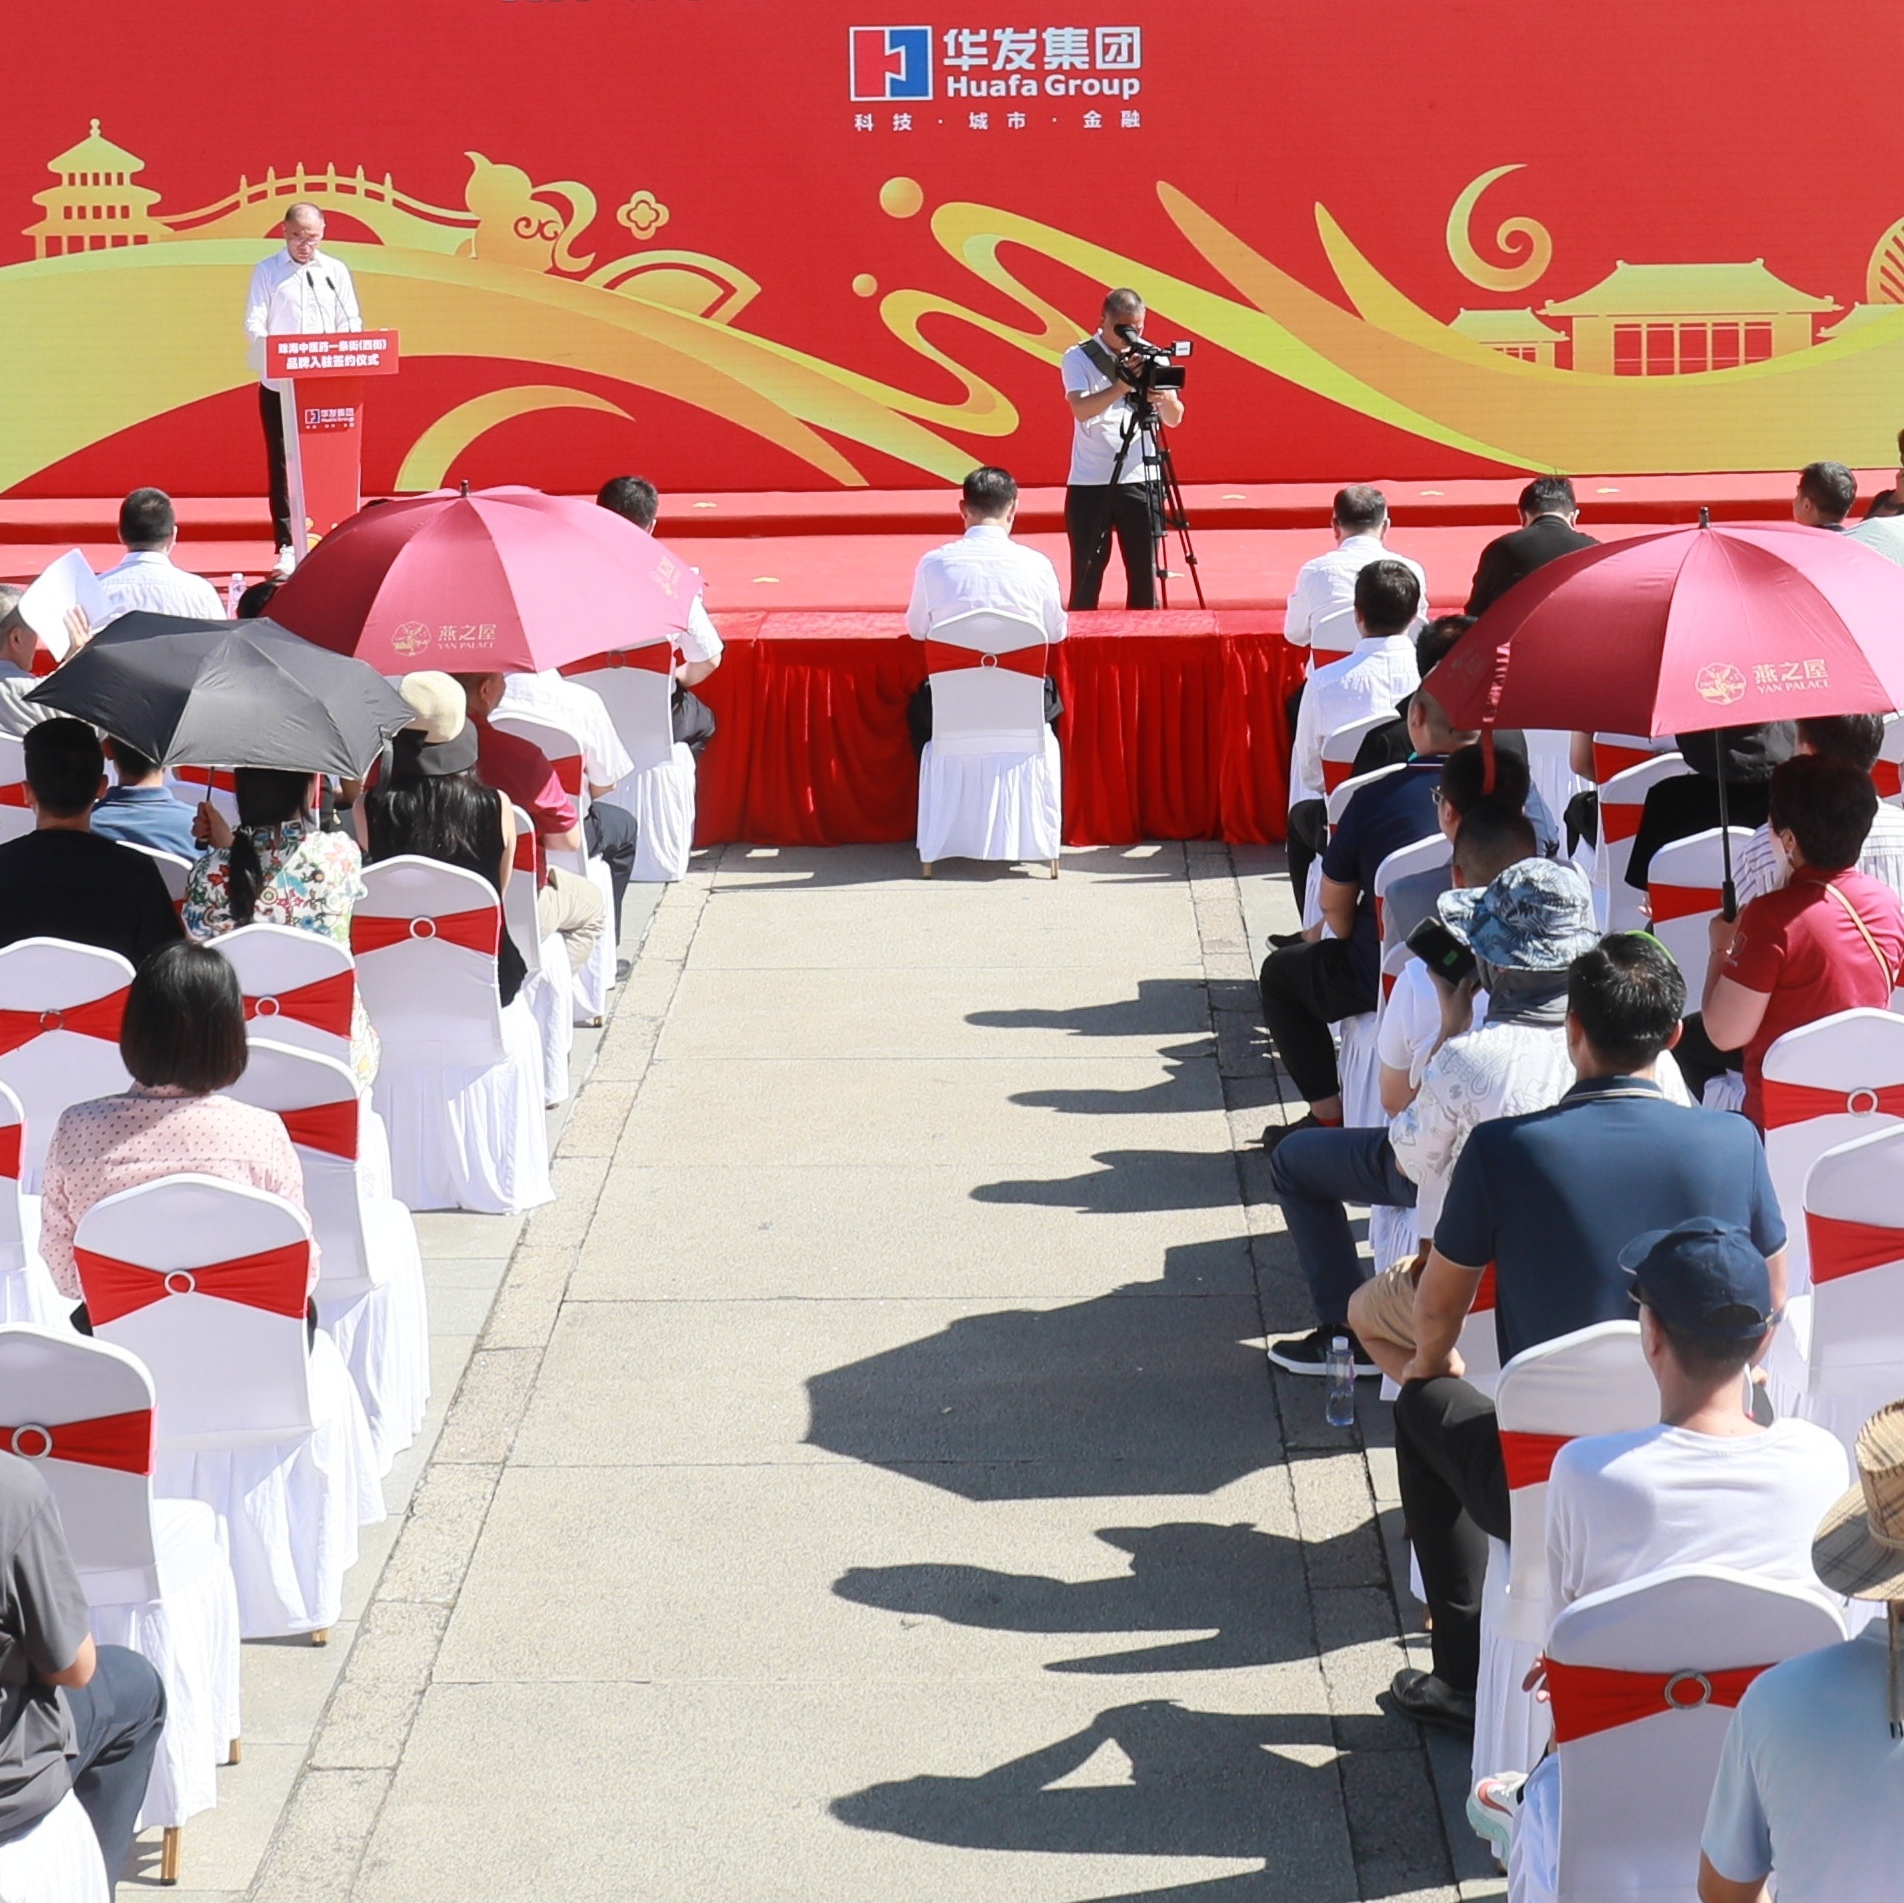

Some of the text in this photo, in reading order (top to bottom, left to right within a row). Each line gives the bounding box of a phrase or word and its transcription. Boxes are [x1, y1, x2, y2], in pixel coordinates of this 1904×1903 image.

[943, 26, 1141, 71] 华发集团
[947, 73, 1140, 100] Huafa Group
[1752, 658, 1829, 684] 燕之屋
[1757, 679, 1831, 694] YAN PALACE
